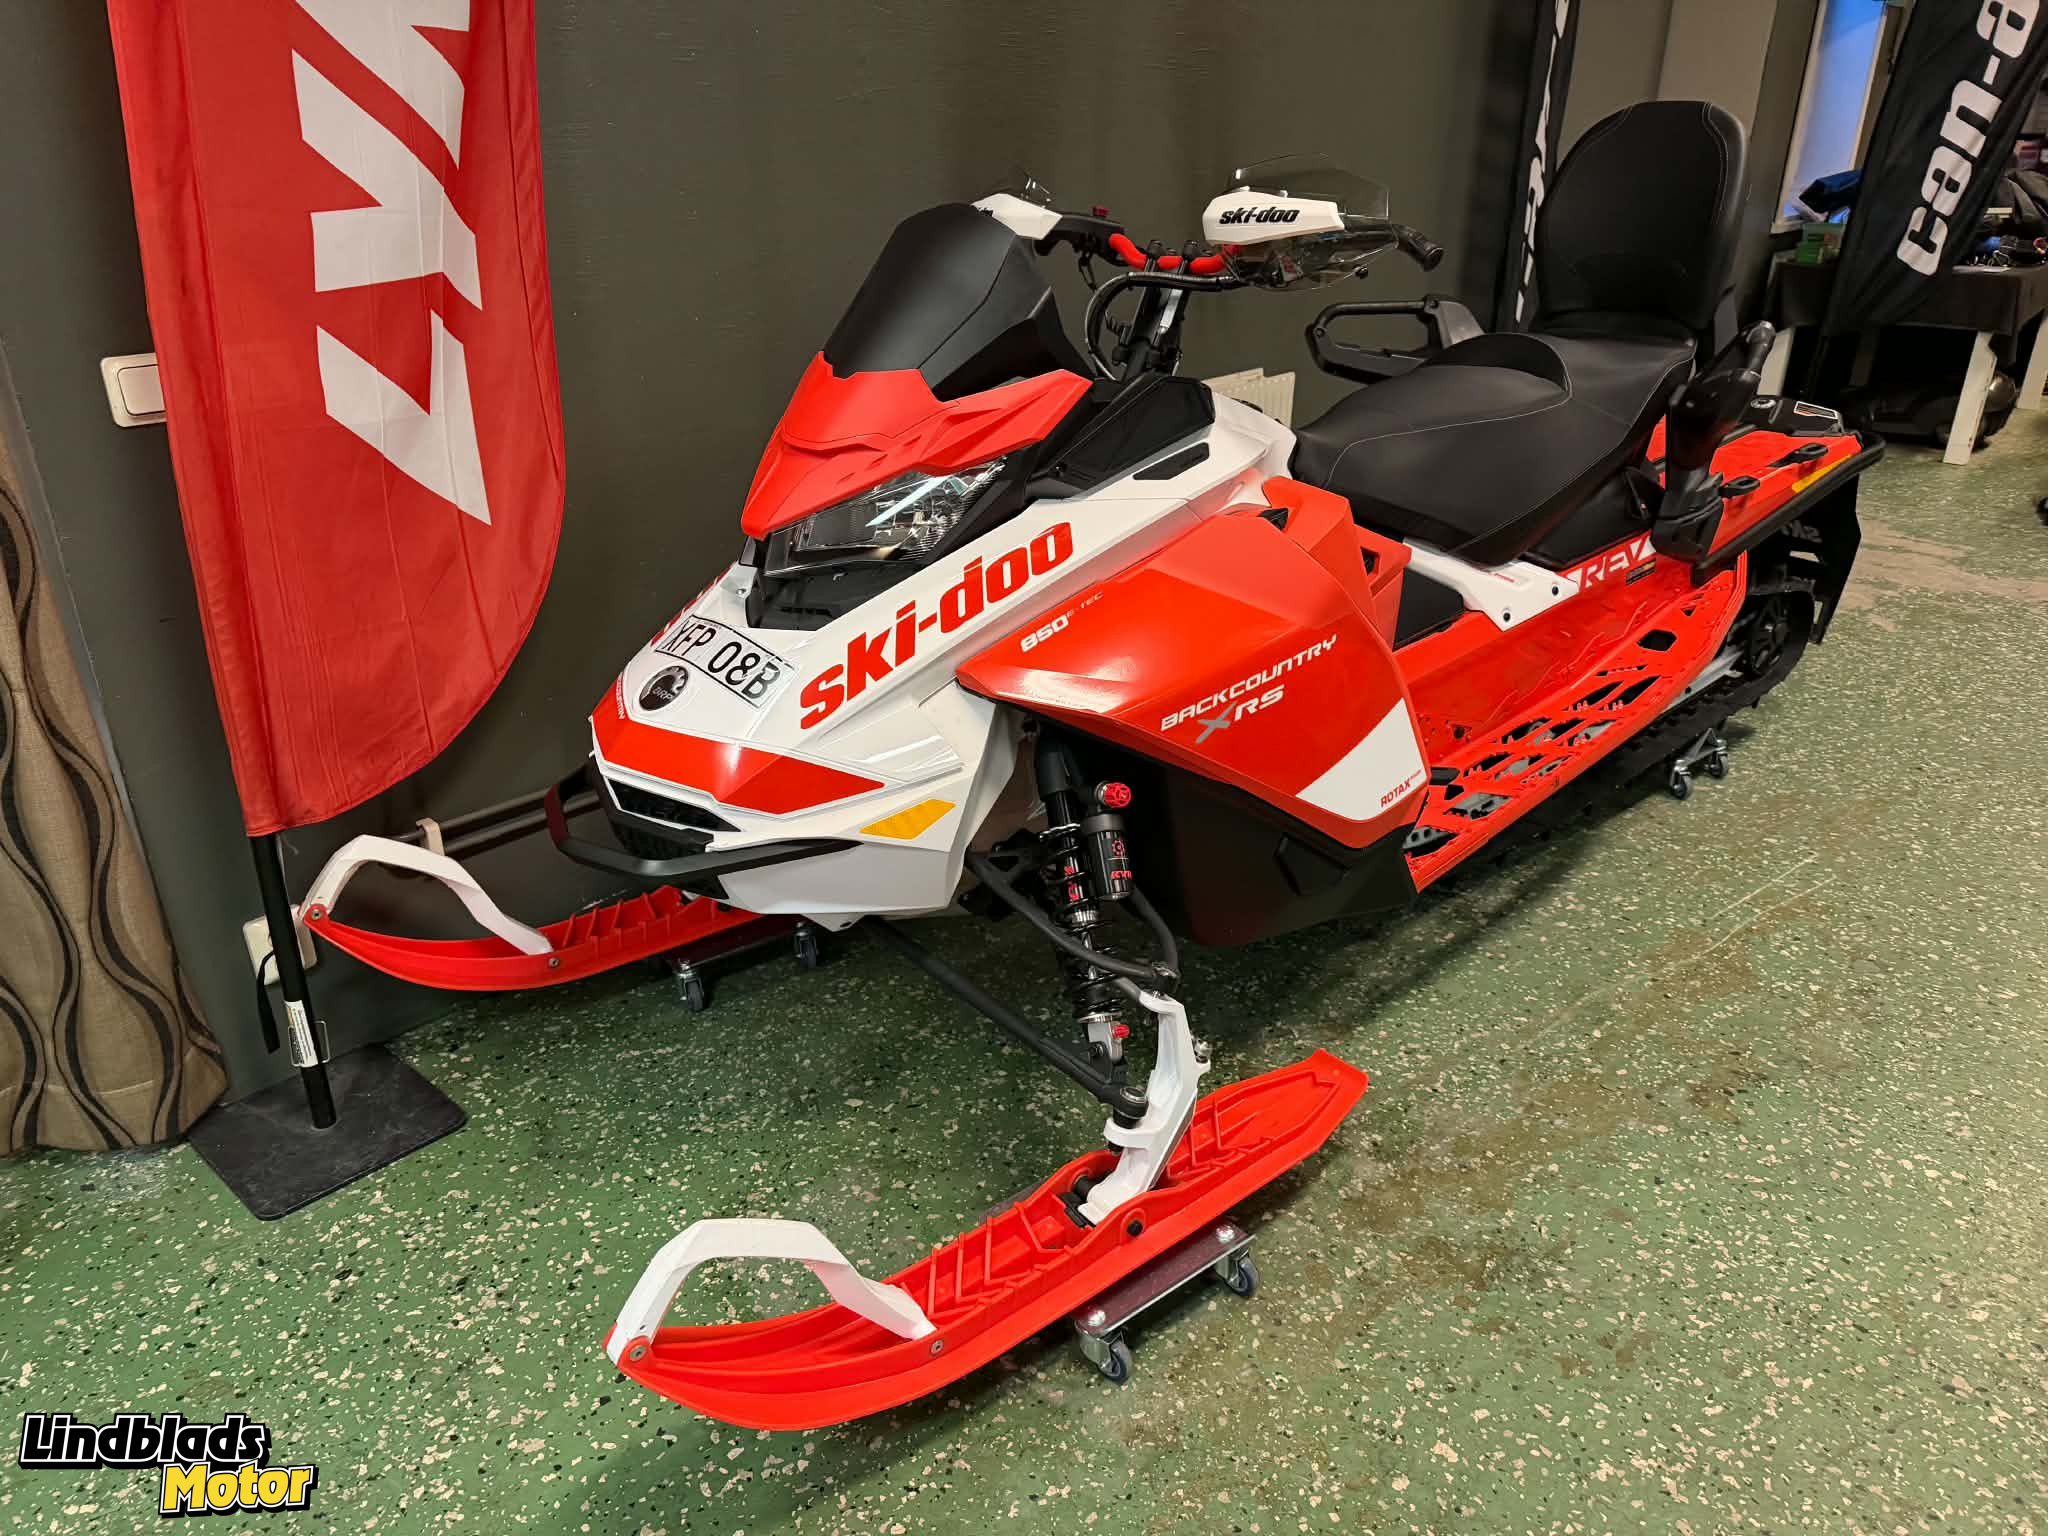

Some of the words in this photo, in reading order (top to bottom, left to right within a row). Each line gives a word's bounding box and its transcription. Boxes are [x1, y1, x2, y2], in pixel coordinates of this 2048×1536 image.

[1219, 206, 1300, 224] ski-doo
[800, 521, 1073, 730] ski-doo
[1020, 614, 1069, 653] 850
[661, 619, 717, 657] XFP
[707, 641, 781, 700] 08B
[1160, 633, 1338, 732] BACKCOUNTRY
[1380, 778, 1411, 808] ROTAX
